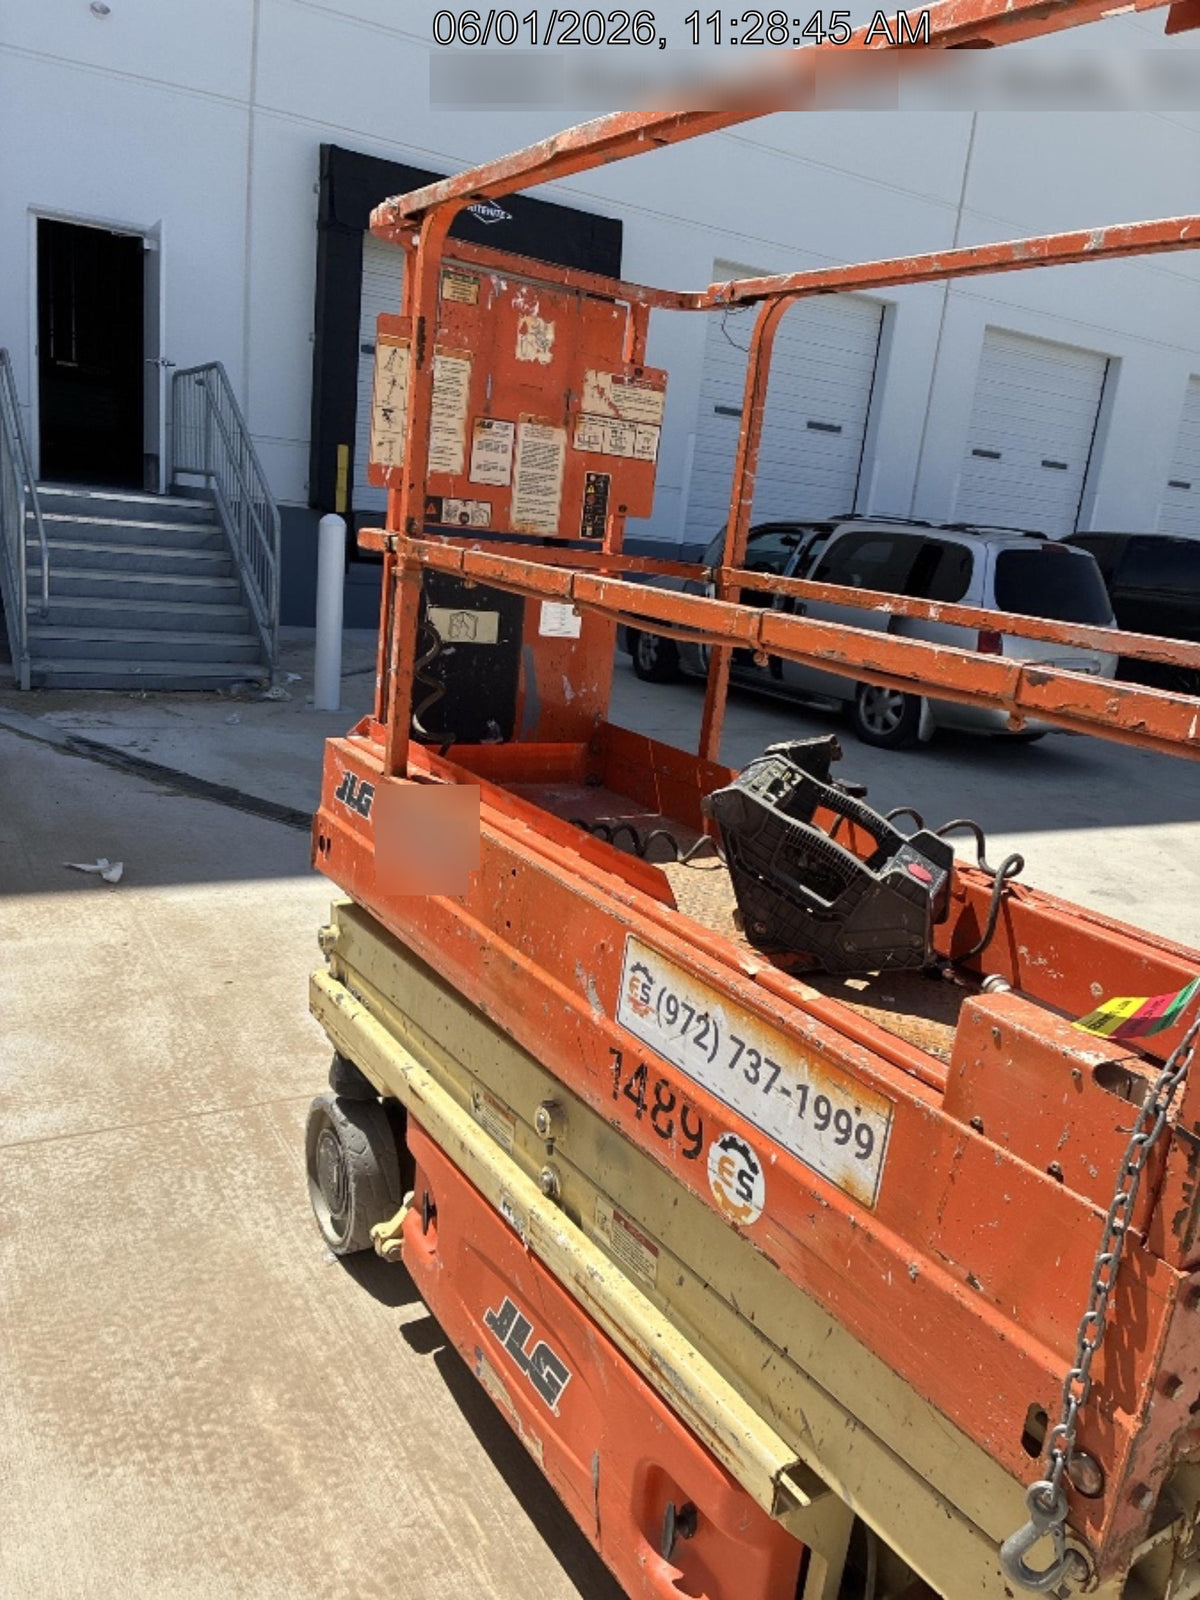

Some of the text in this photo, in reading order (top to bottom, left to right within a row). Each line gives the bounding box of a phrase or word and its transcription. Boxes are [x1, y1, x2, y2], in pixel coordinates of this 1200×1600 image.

[335, 769, 376, 819] JLG
[609, 1046, 704, 1160] 1489
[656, 986, 719, 1064] (972)
[728, 1034, 875, 1160] 737-1999
[482, 1295, 573, 1410] JLG
